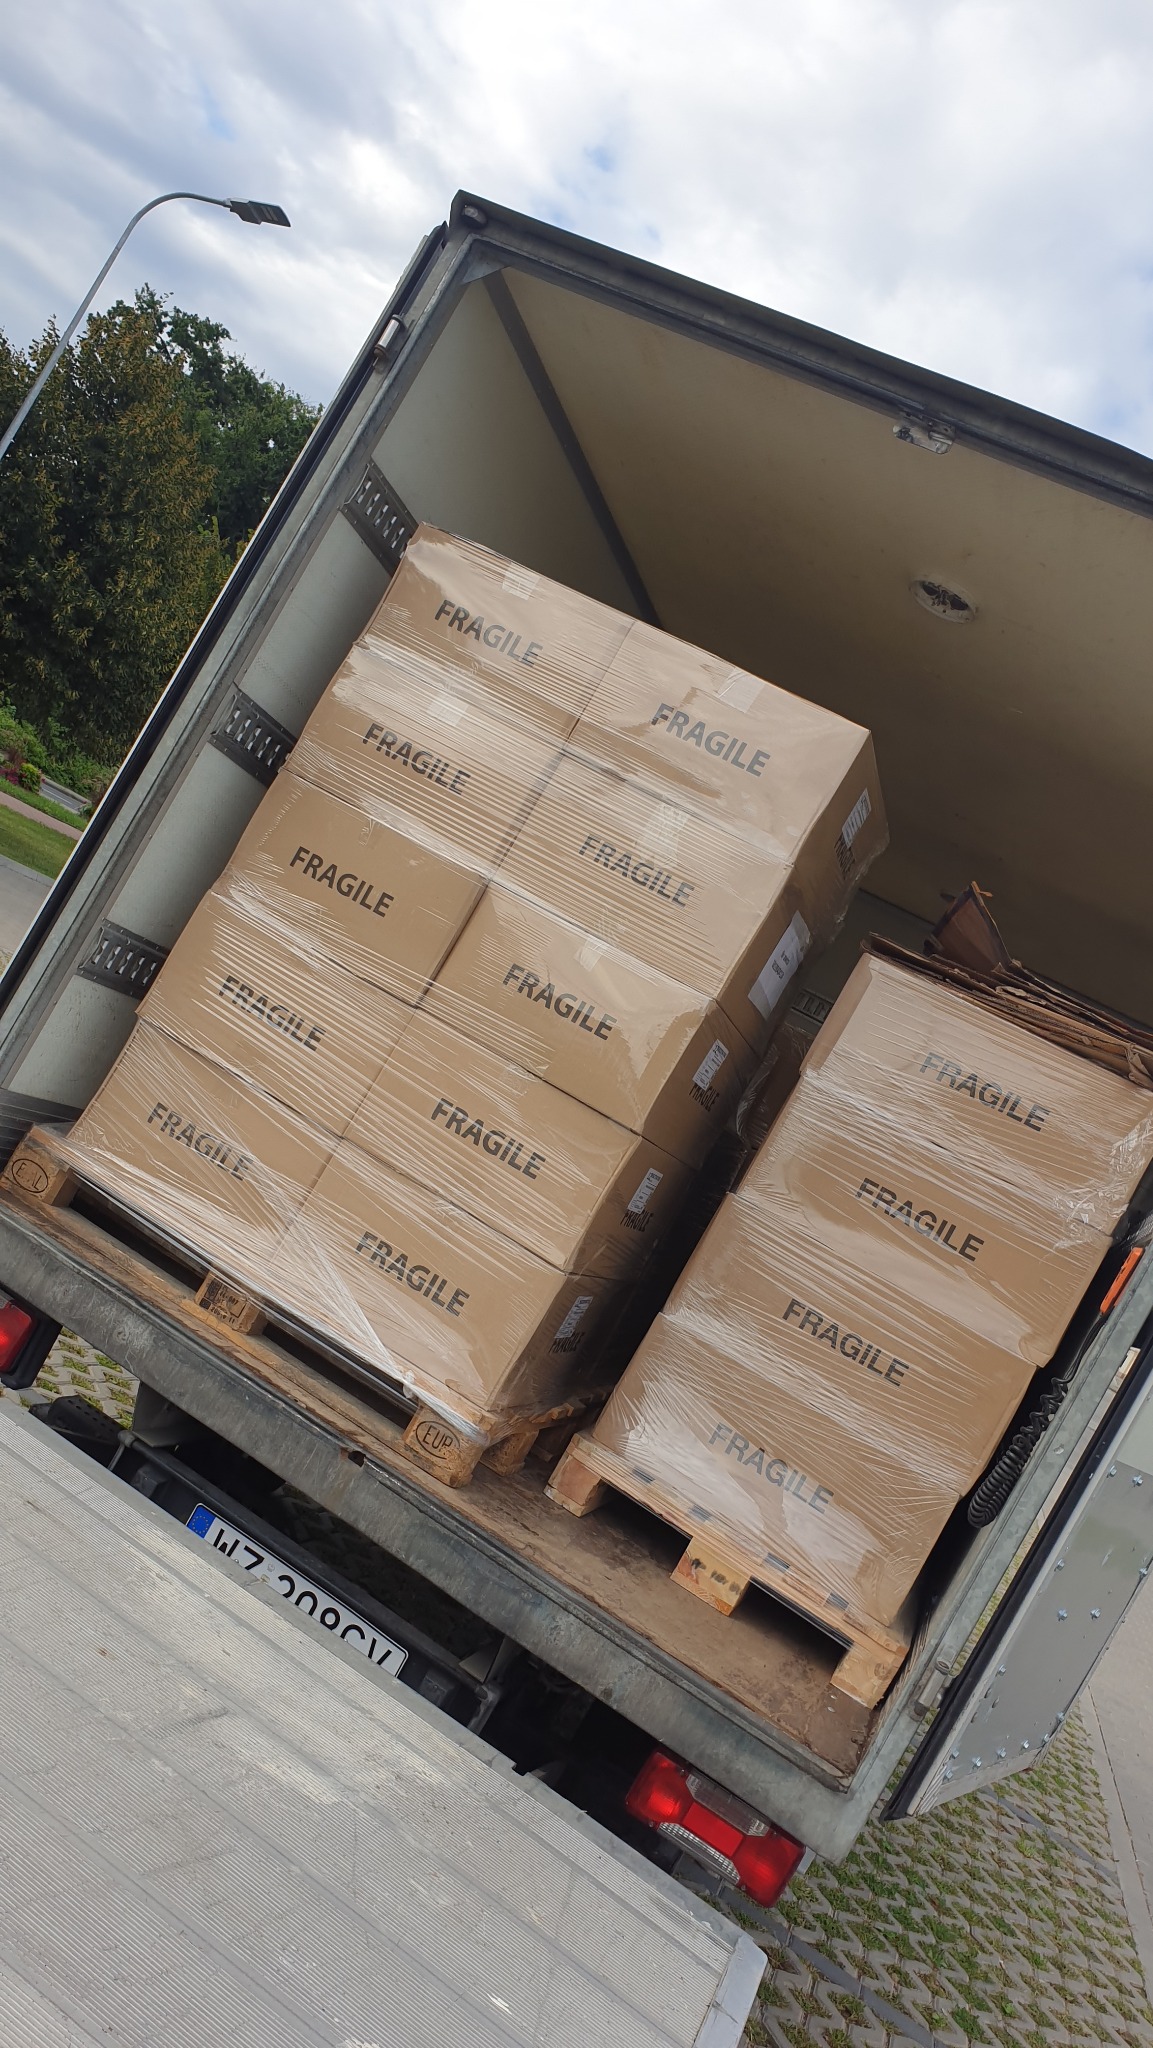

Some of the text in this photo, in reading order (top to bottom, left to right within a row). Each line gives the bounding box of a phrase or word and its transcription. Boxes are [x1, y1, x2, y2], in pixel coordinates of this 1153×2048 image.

[434, 599, 544, 667] FRAGILE
[362, 722, 471, 795] FRAGILE
[651, 703, 771, 777] FRAGILE
[290, 846, 395, 917] FRAGILE
[578, 834, 696, 908] FRAGILE
[218, 975, 327, 1052] FRAGILE
[502, 963, 617, 1041] FRAGILE
[919, 1051, 1051, 1132] FRAGILE
[147, 1102, 254, 1181] FRAGILE
[431, 1098, 546, 1179] FRAGILE
[854, 1178, 985, 1262] FRAGILE
[355, 1232, 470, 1317] FRAGILE
[781, 1298, 913, 1388] FRAGILE
[707, 1423, 834, 1515] FRAGILE
